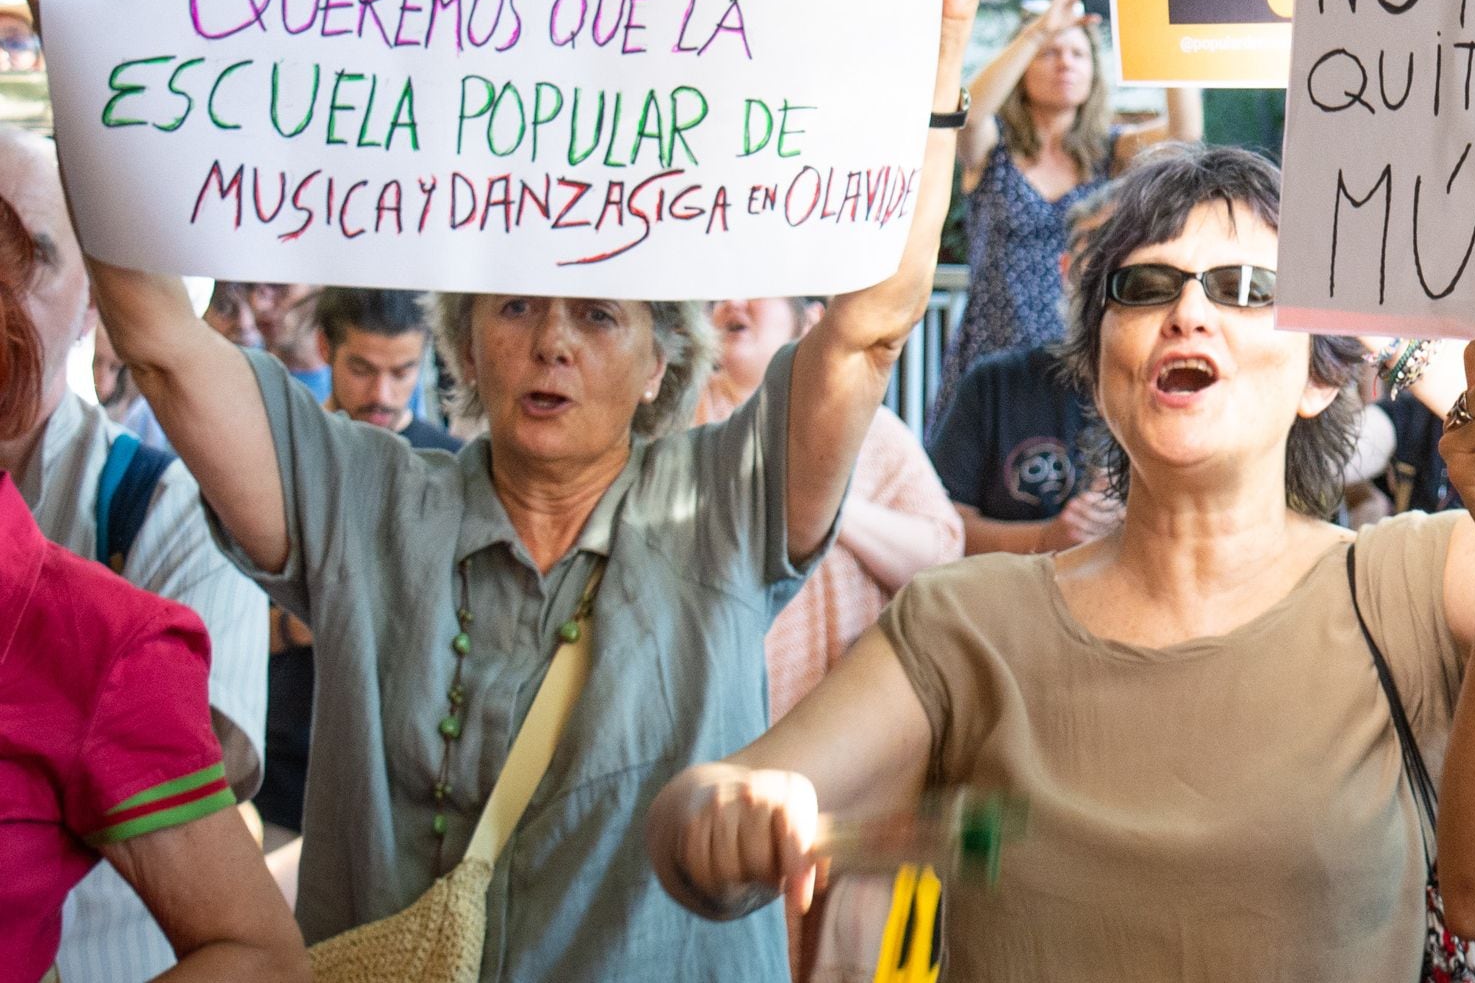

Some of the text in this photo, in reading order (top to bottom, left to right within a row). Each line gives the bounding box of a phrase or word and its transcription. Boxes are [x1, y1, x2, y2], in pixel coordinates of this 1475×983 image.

[101, 55, 819, 174] ESCUELA POPULAR DE
[189, 158, 922, 266] MUSICA Y DANZA SIGA EN OLAVIDE
